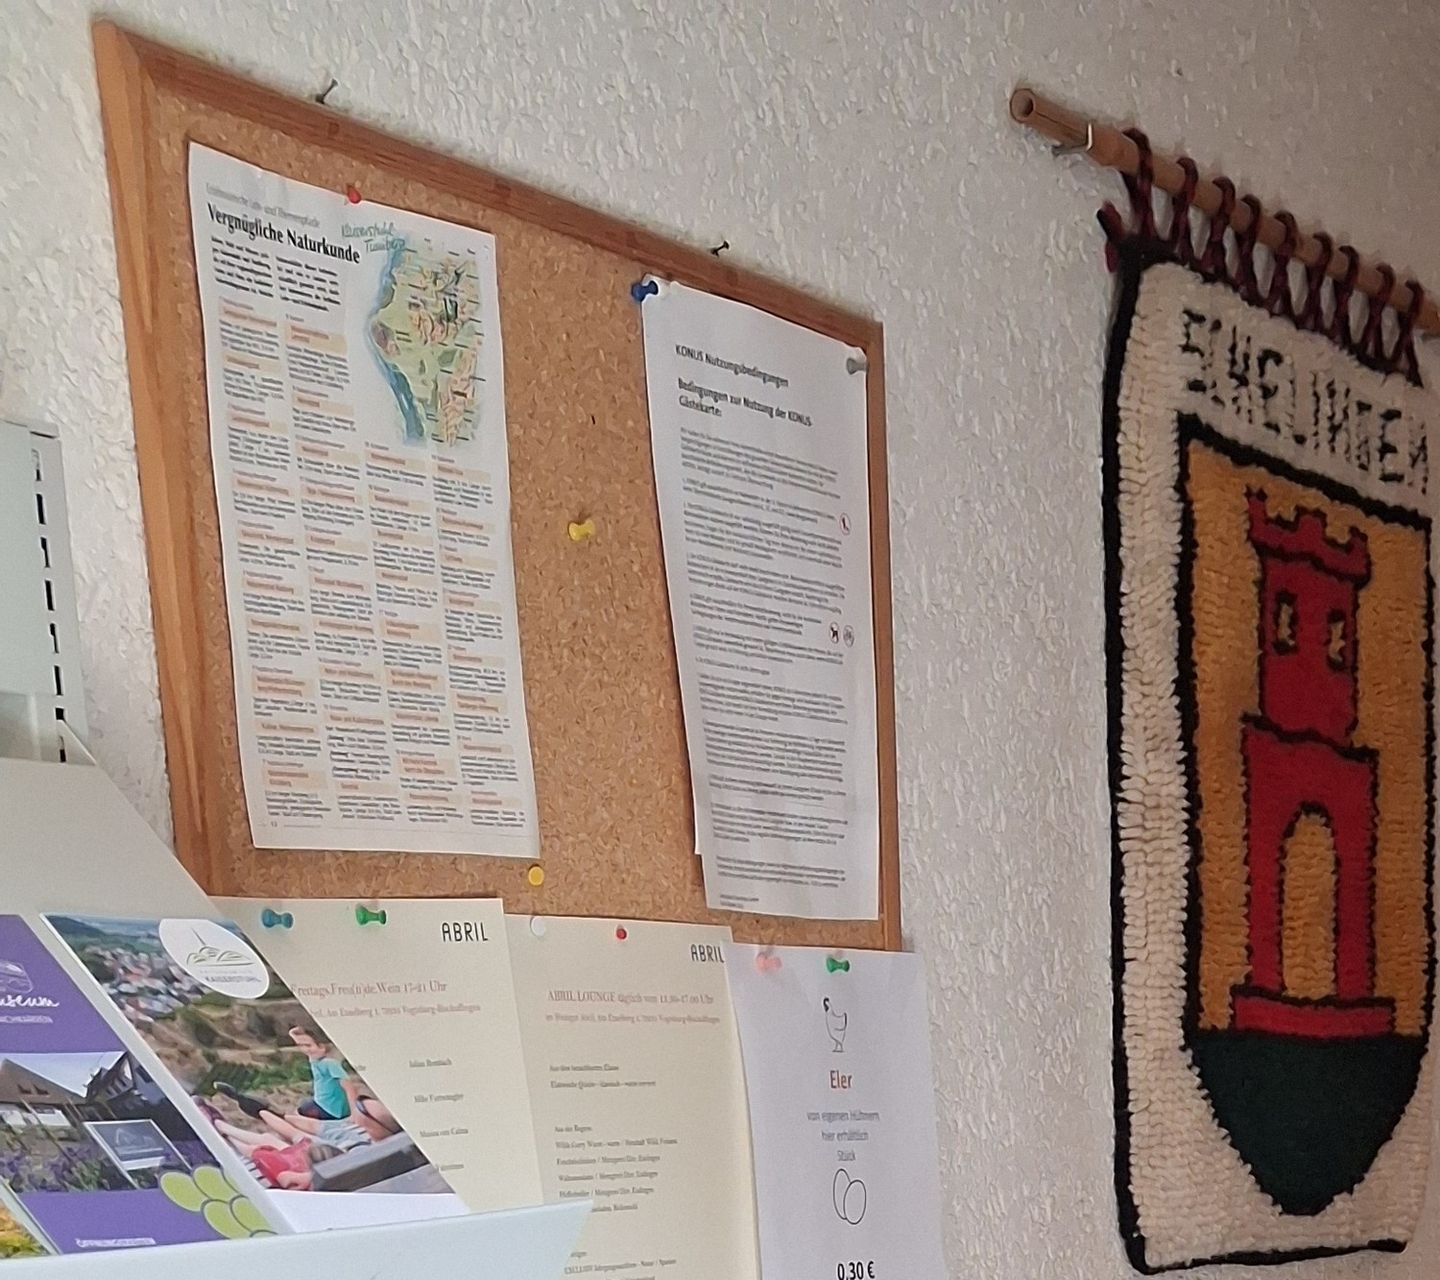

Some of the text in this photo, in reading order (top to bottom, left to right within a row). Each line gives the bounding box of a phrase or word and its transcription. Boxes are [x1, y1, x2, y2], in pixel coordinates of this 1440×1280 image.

[207, 202, 361, 264] Vergnügliche Naturkunde
[675, 344, 789, 389] KONUS Nutzungsbedingungen
[678, 377, 728, 403] Bedingungen
[730, 395, 742, 405] zur
[743, 397, 774, 418] Nutzung
[775, 406, 787, 419] der
[441, 922, 488, 943] ABRIL
[690, 943, 725, 963] ABRIL
[429, 979, 448, 992] Uhr
[549, 989, 577, 1002] ABRIL
[578, 989, 616, 1002] LOUNGE
[867, 1260, 875, 1279] €
